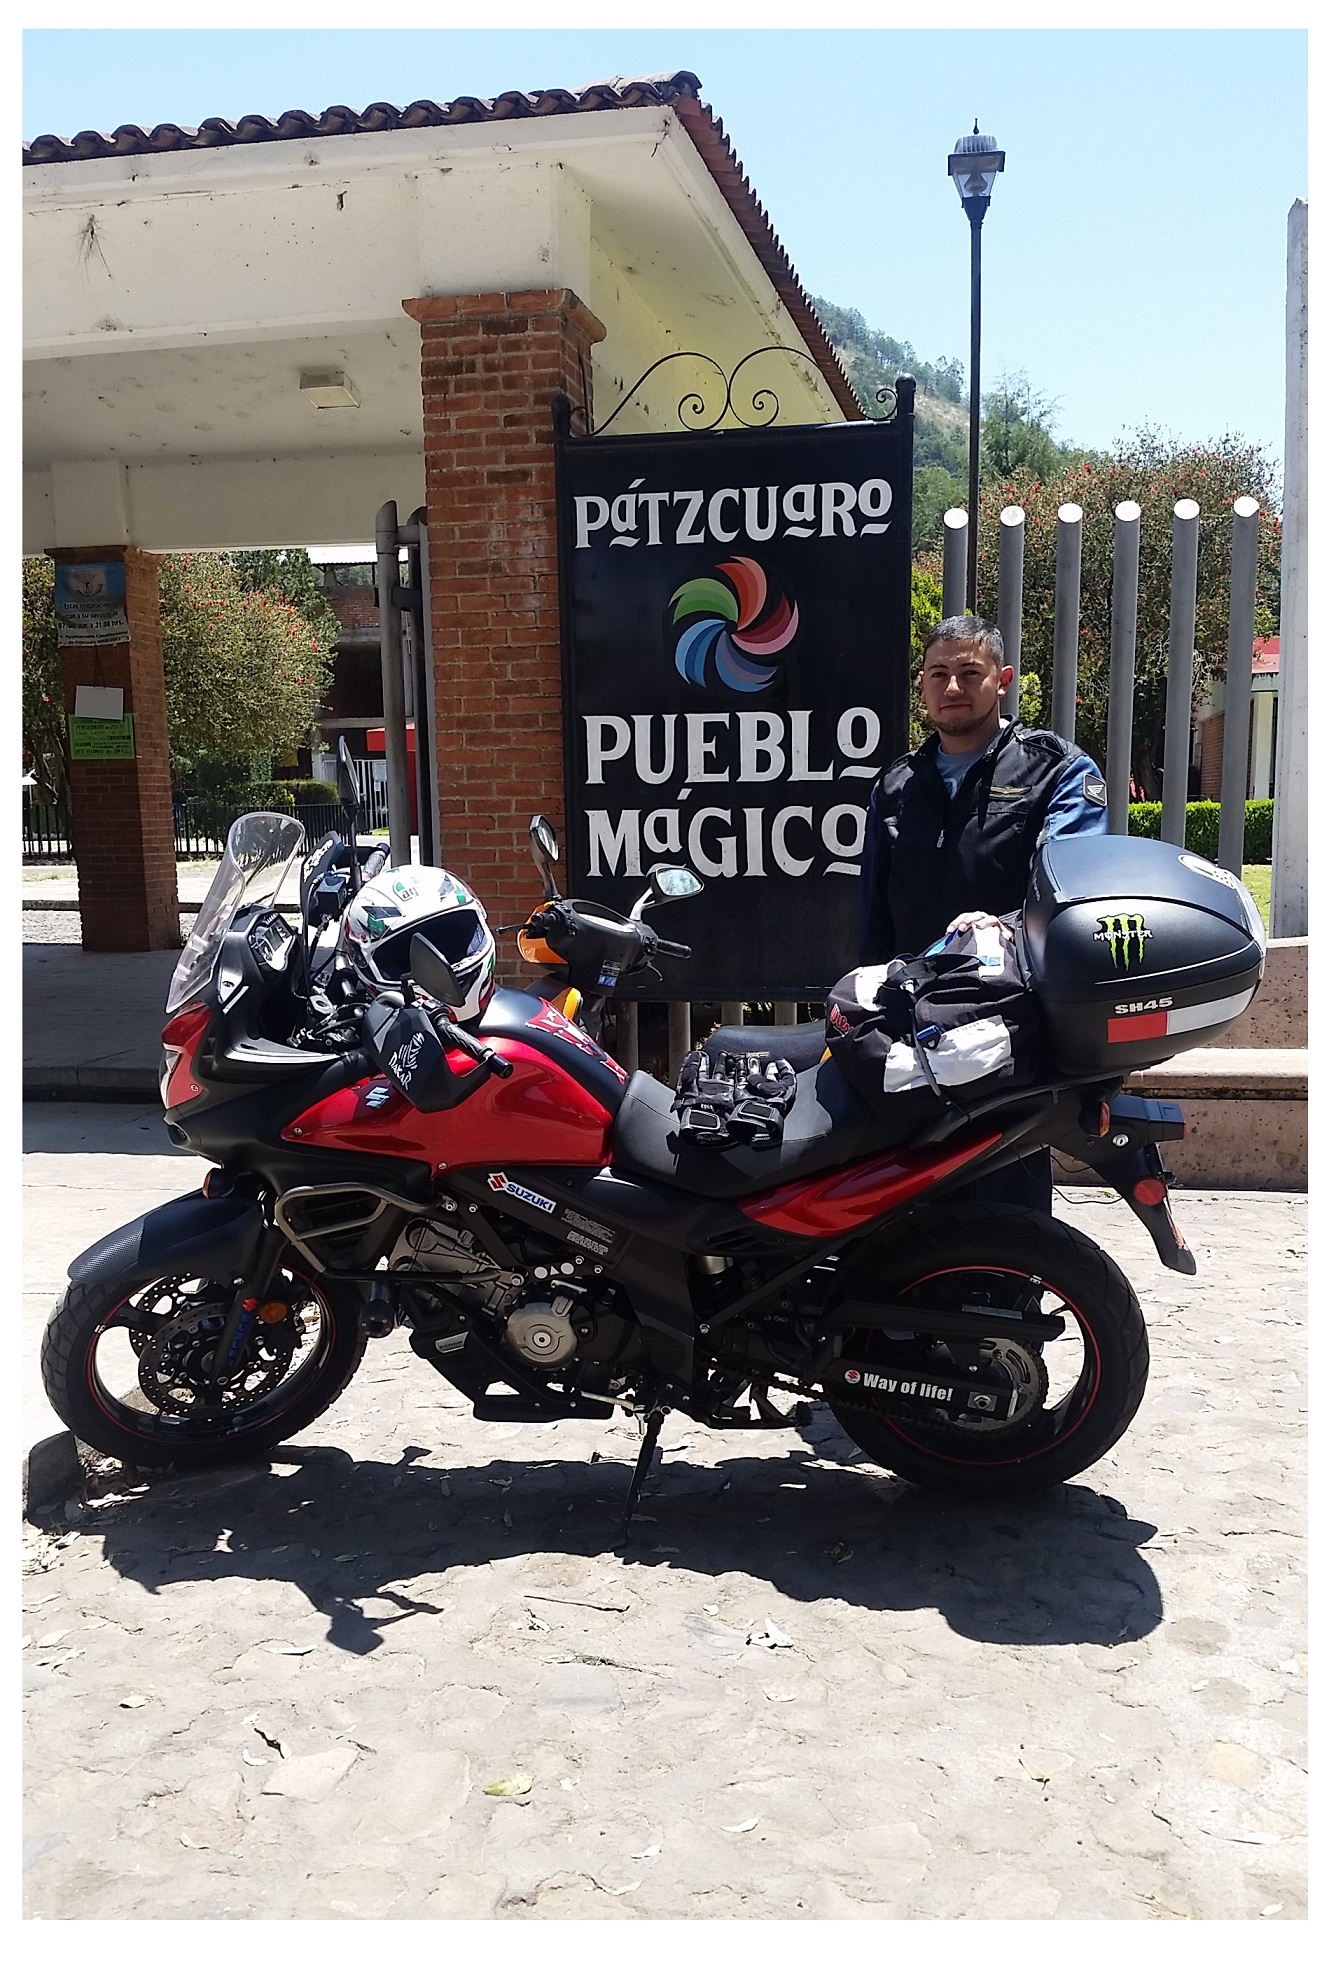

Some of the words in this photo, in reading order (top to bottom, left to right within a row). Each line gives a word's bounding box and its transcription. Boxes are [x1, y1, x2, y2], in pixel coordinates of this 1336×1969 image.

[1094, 929, 1154, 941] MONSTER
[1114, 997, 1173, 1014] SH45
[388, 1051, 412, 1091] DAKAR
[506, 1183, 553, 1211] SUZUKI
[863, 1372, 898, 1392] Way
[900, 1381, 918, 1395] of
[919, 1382, 953, 1401] life!
